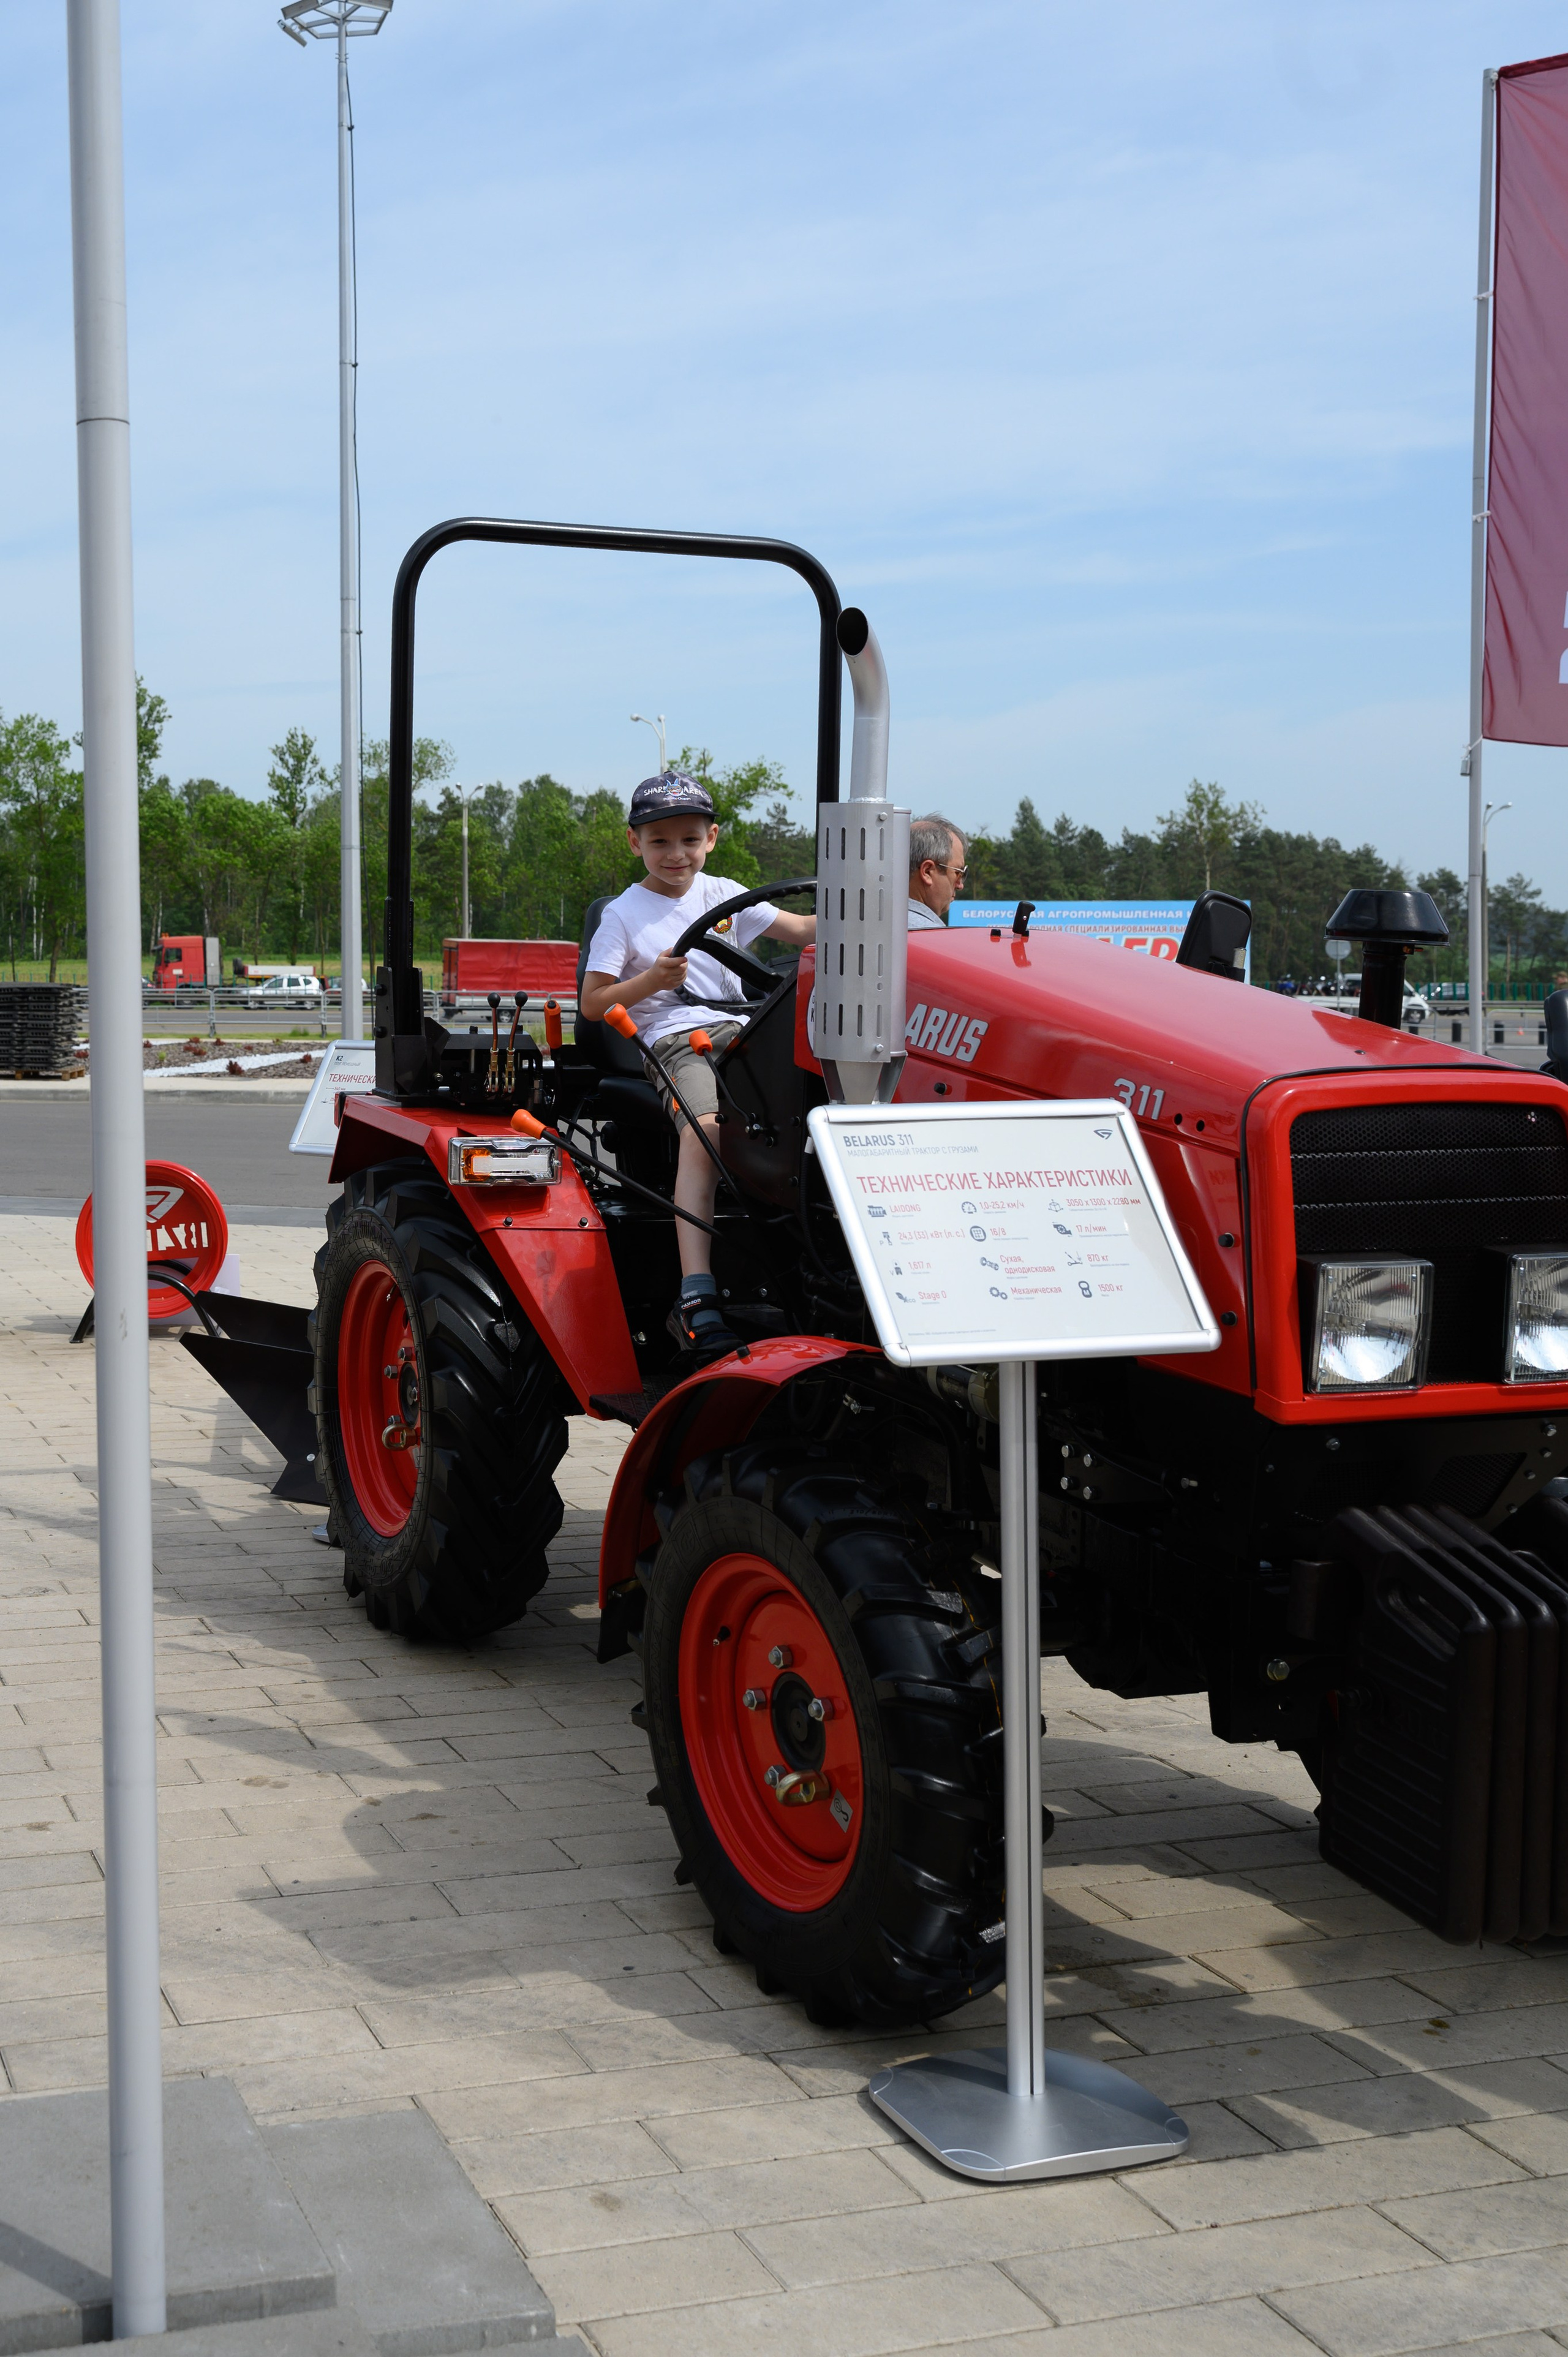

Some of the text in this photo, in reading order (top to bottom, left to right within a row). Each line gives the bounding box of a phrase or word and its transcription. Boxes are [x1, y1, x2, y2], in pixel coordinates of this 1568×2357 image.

[962, 910, 1044, 919] БЕЛОРУСАЯ
[1047, 910, 1183, 919] АГРОПРОМЫШЛЕННАЯ
[1065, 924, 1167, 933] СПЕЦИАЛИЗИРОВАННАЯ
[905, 1003, 989, 1062] ARUS
[329, 1074, 375, 1084] ТЕХНИЧЕСКИ
[1110, 1078, 1164, 1120] 311
[843, 1134, 914, 1147] BELARUS 311
[847, 1147, 910, 1157] МАЛОГАБАРИТНЫЙ
[948, 1145, 979, 1154] ГРУЗАМИ
[856, 1169, 1133, 1193] ТЕХНИЧЕСКИЕ ХАРАКТЕРИСТИКИ
[889, 1204, 921, 1213] LAIDONG
[979, 1199, 1025, 1210] 1,0-25,2 км/ч
[990, 1227, 1006, 1237] 16/8
[1085, 1224, 1107, 1233] л/мин
[898, 1232, 913, 1240] 24,3
[908, 1261, 924, 1270] 1,617
[1005, 1265, 1055, 1274] однодисковая
[918, 1291, 940, 1300] Stage
